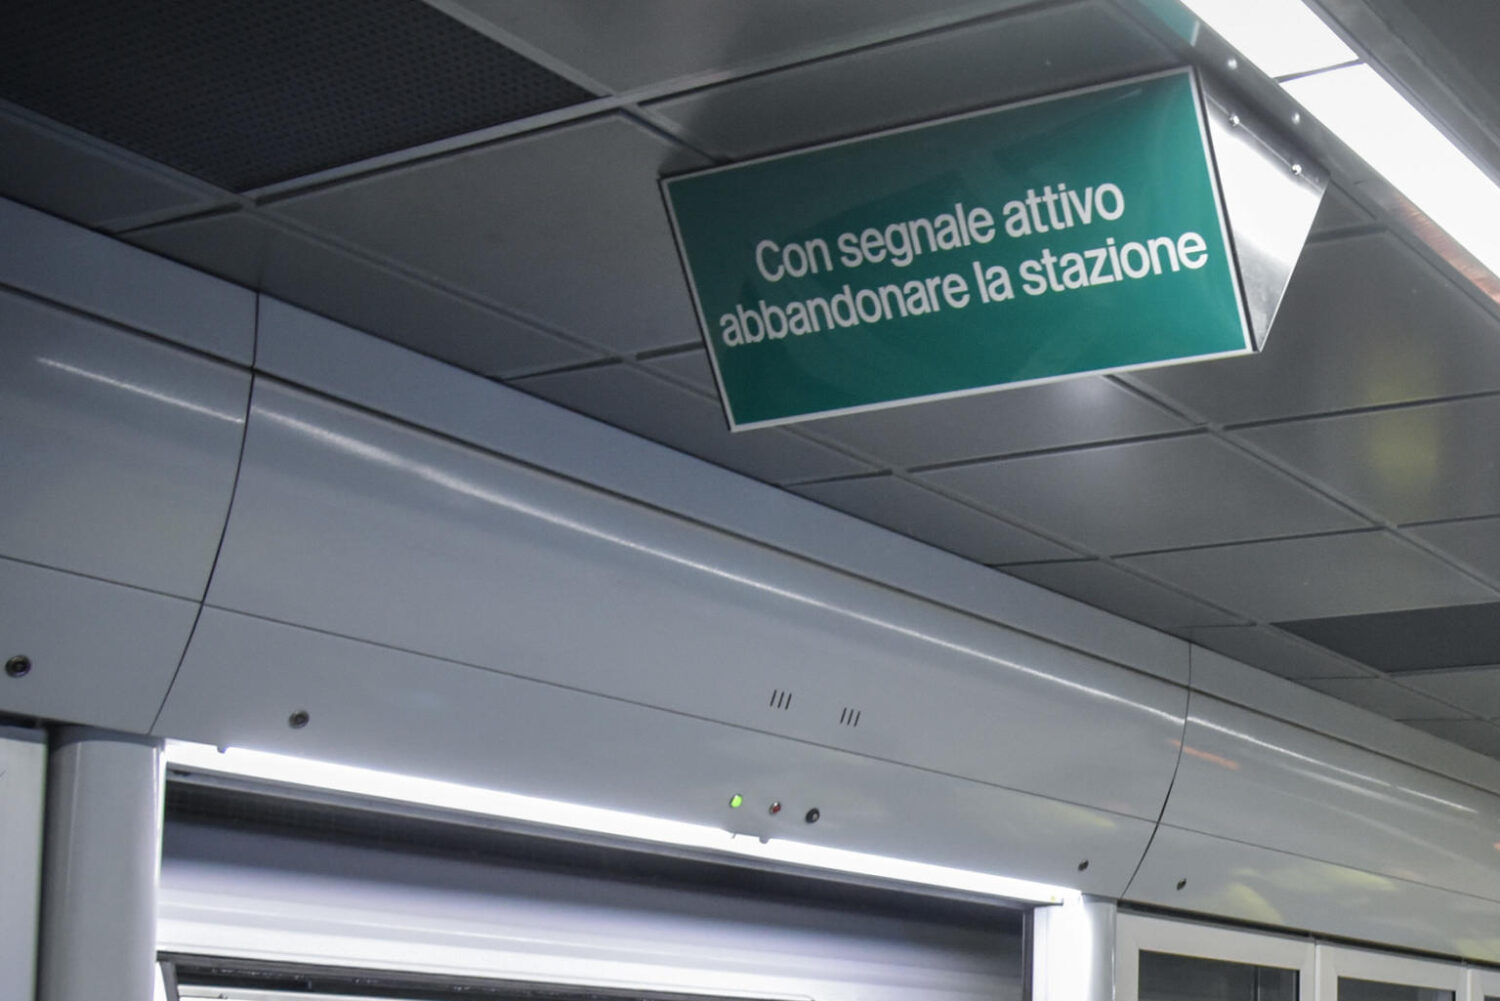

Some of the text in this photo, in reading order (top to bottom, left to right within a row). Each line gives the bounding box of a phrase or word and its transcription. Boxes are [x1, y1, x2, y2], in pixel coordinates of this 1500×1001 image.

[754, 182, 1125, 283] Con segnale attivo
[719, 231, 1209, 348] abbandonare la stazione
